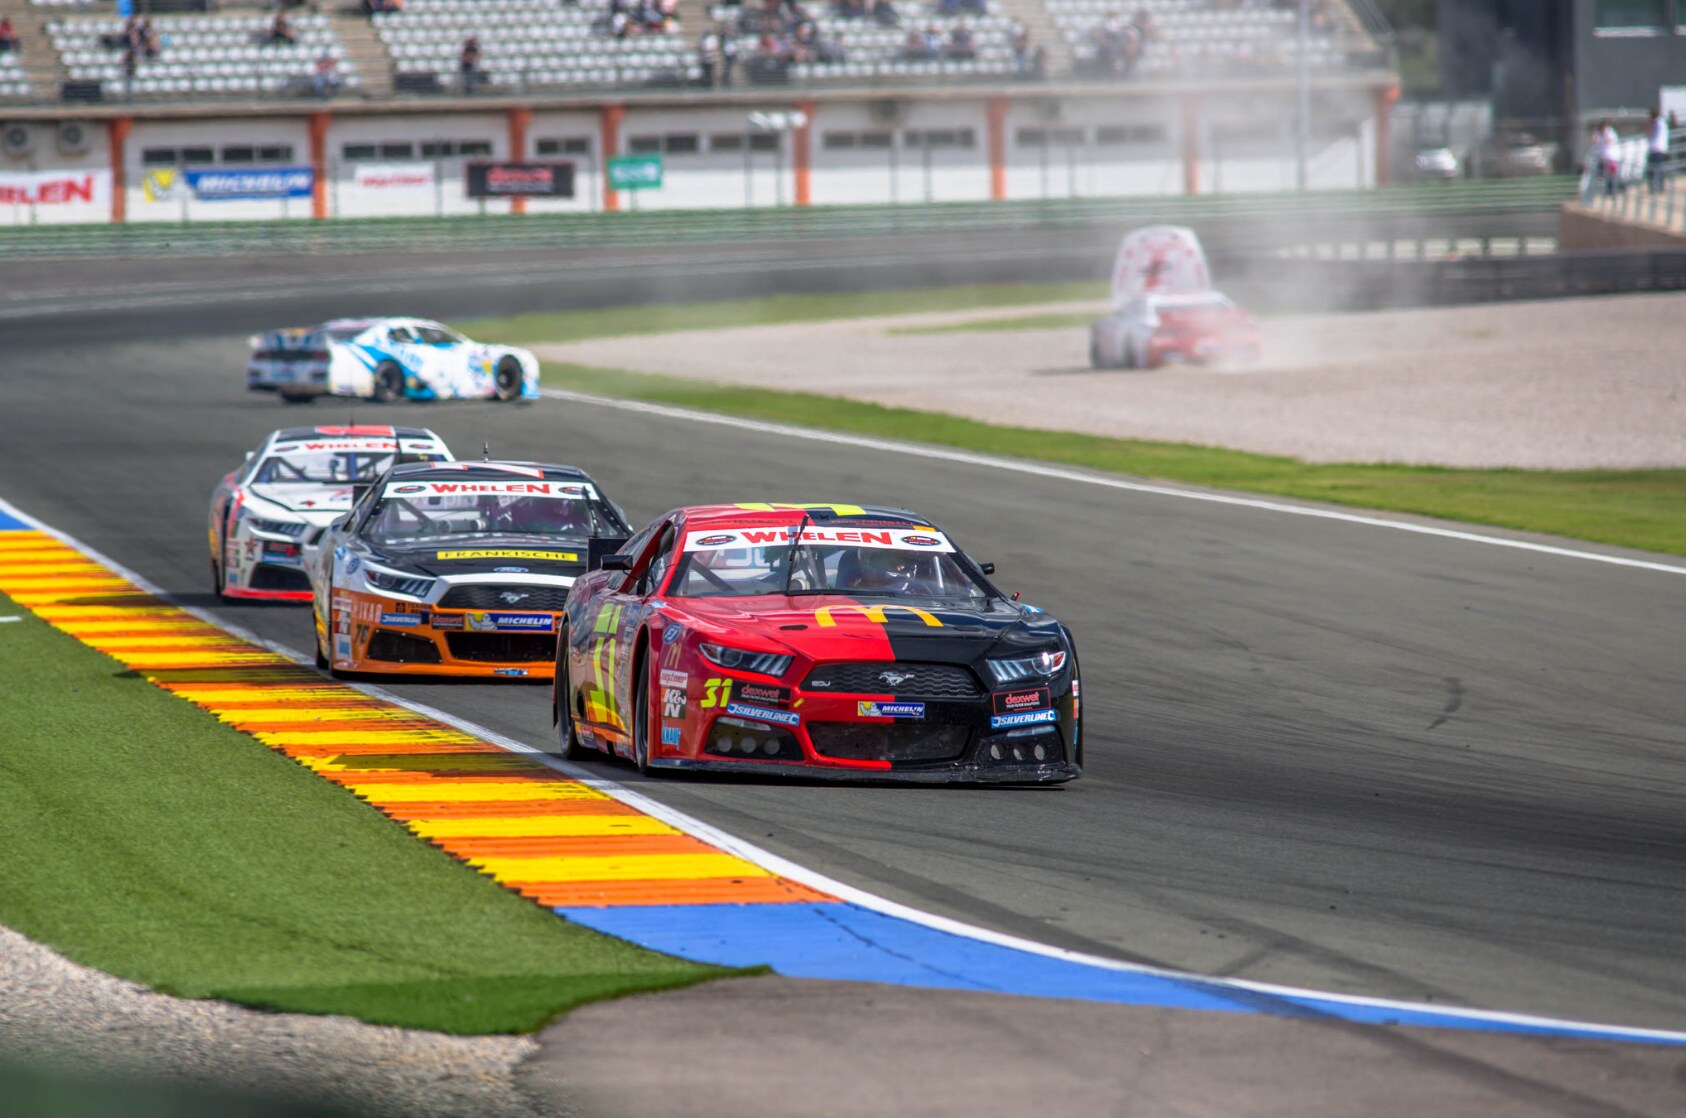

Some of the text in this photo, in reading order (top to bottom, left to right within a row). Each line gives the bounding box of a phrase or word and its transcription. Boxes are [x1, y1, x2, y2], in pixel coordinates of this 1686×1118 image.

[431, 483, 550, 494] WHELEN
[740, 531, 893, 546] WHELEN
[497, 616, 553, 625] MICHELIN
[700, 677, 733, 708] 31
[741, 684, 780, 699] dexwet
[1005, 691, 1040, 705] dexwet
[881, 705, 923, 715] MICHELIN
